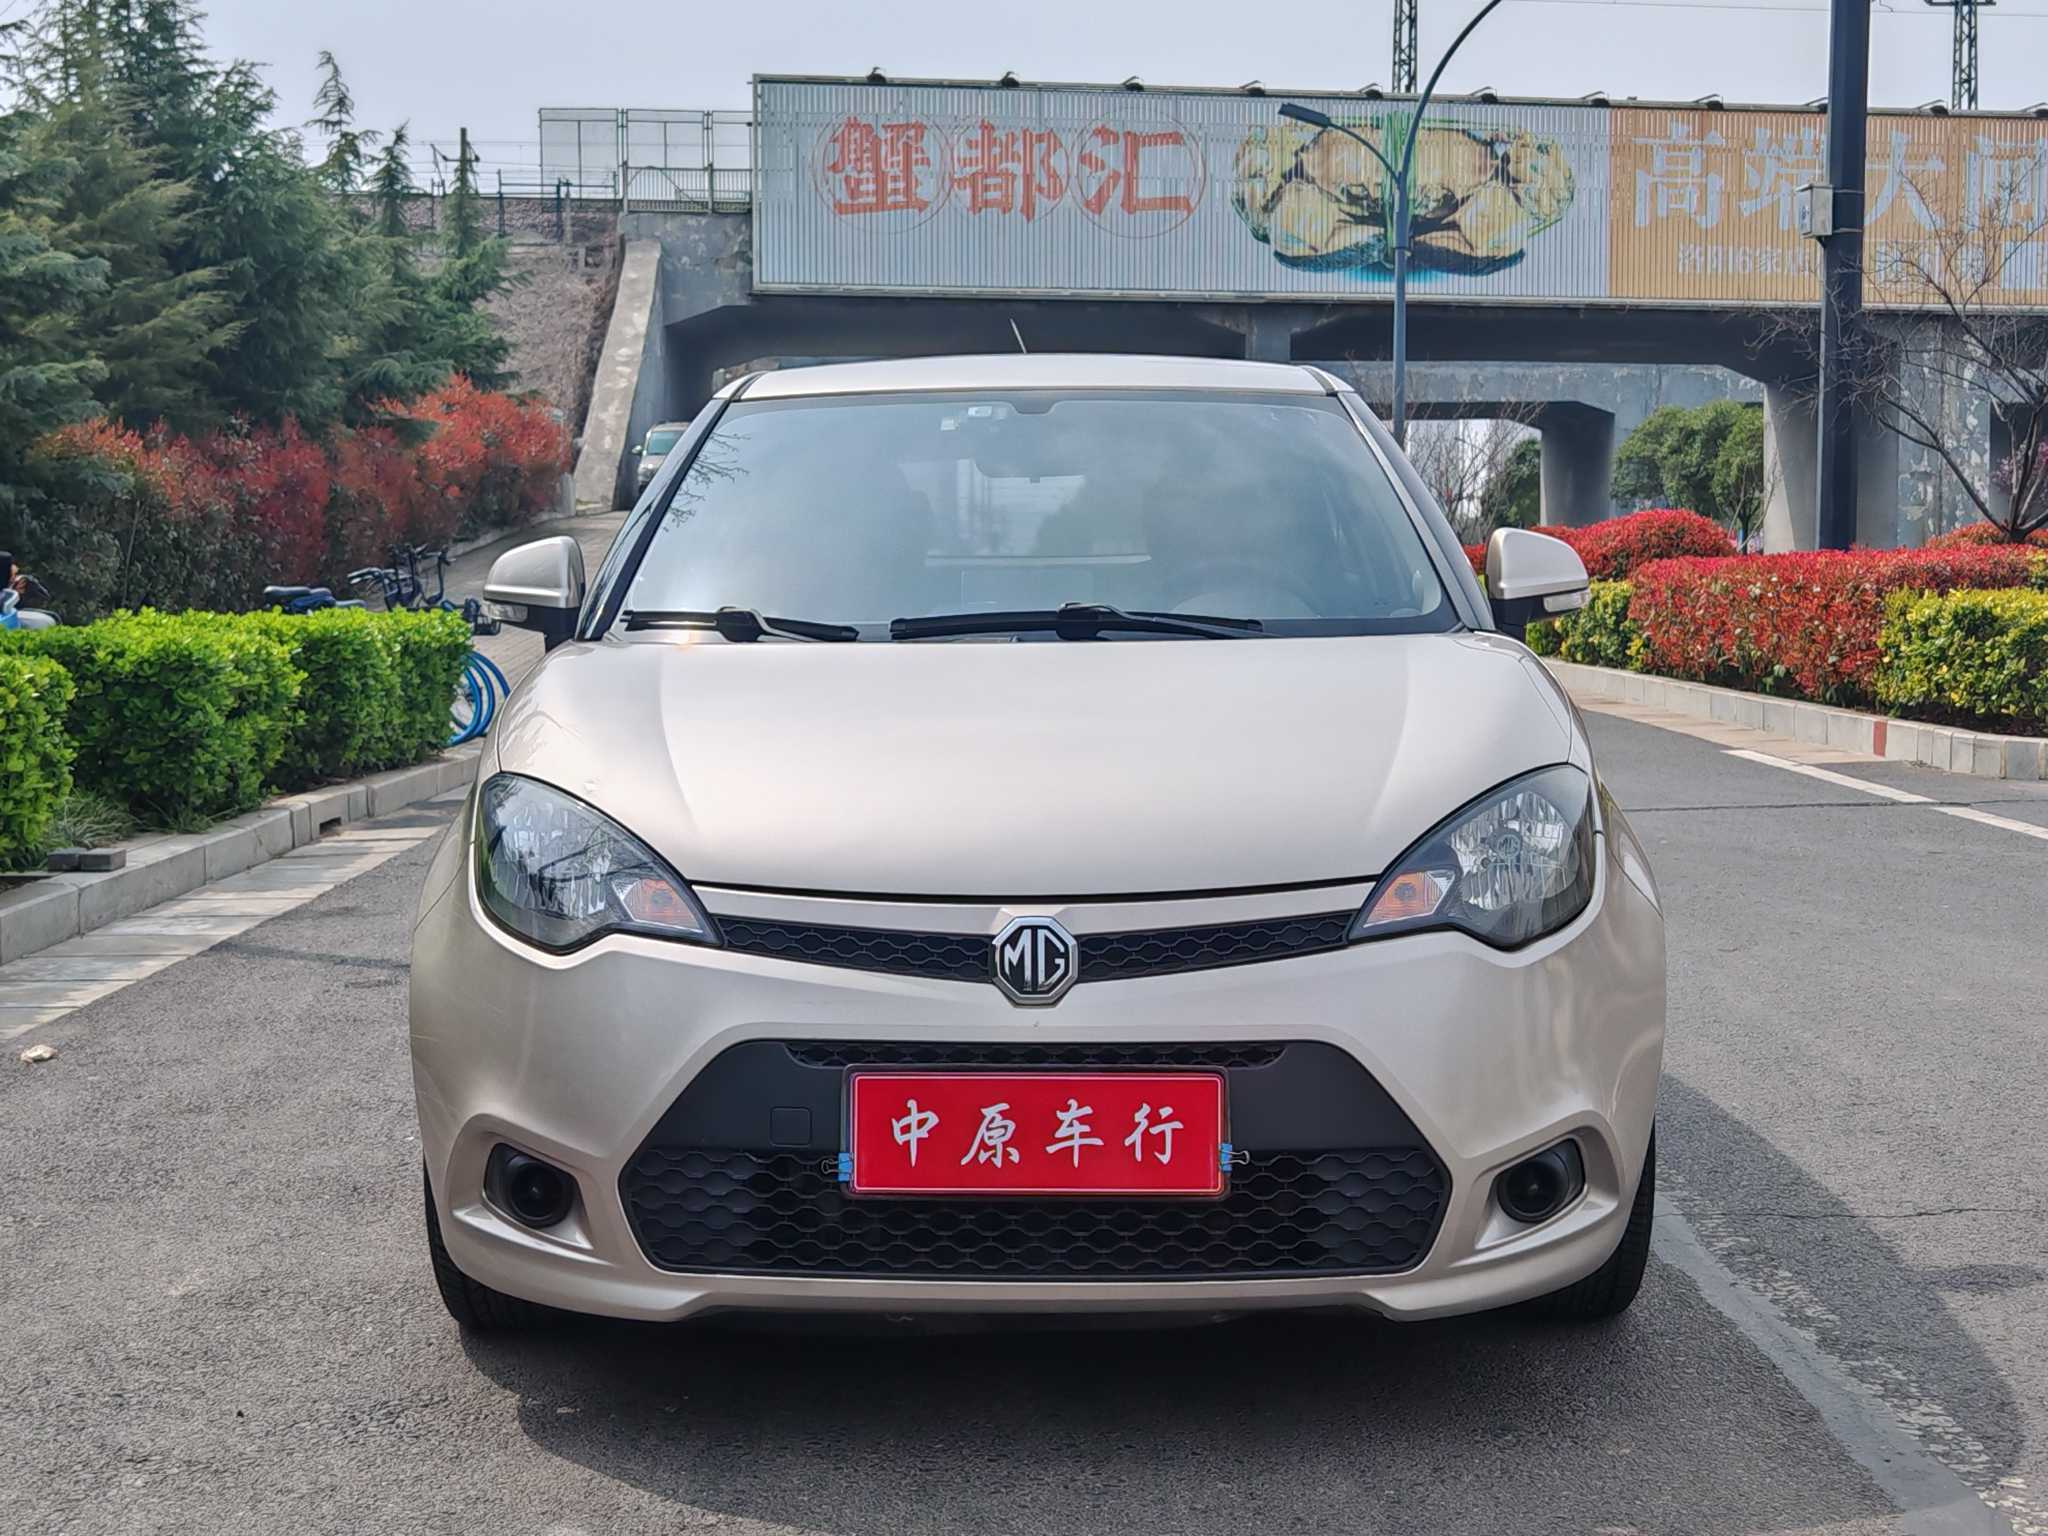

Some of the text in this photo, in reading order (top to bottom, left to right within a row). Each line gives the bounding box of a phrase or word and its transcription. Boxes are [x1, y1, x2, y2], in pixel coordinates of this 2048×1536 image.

[826, 117, 1194, 220] 蟹都汇
[1003, 927, 1066, 992] MG
[890, 1098, 1184, 1168] 中原车行
